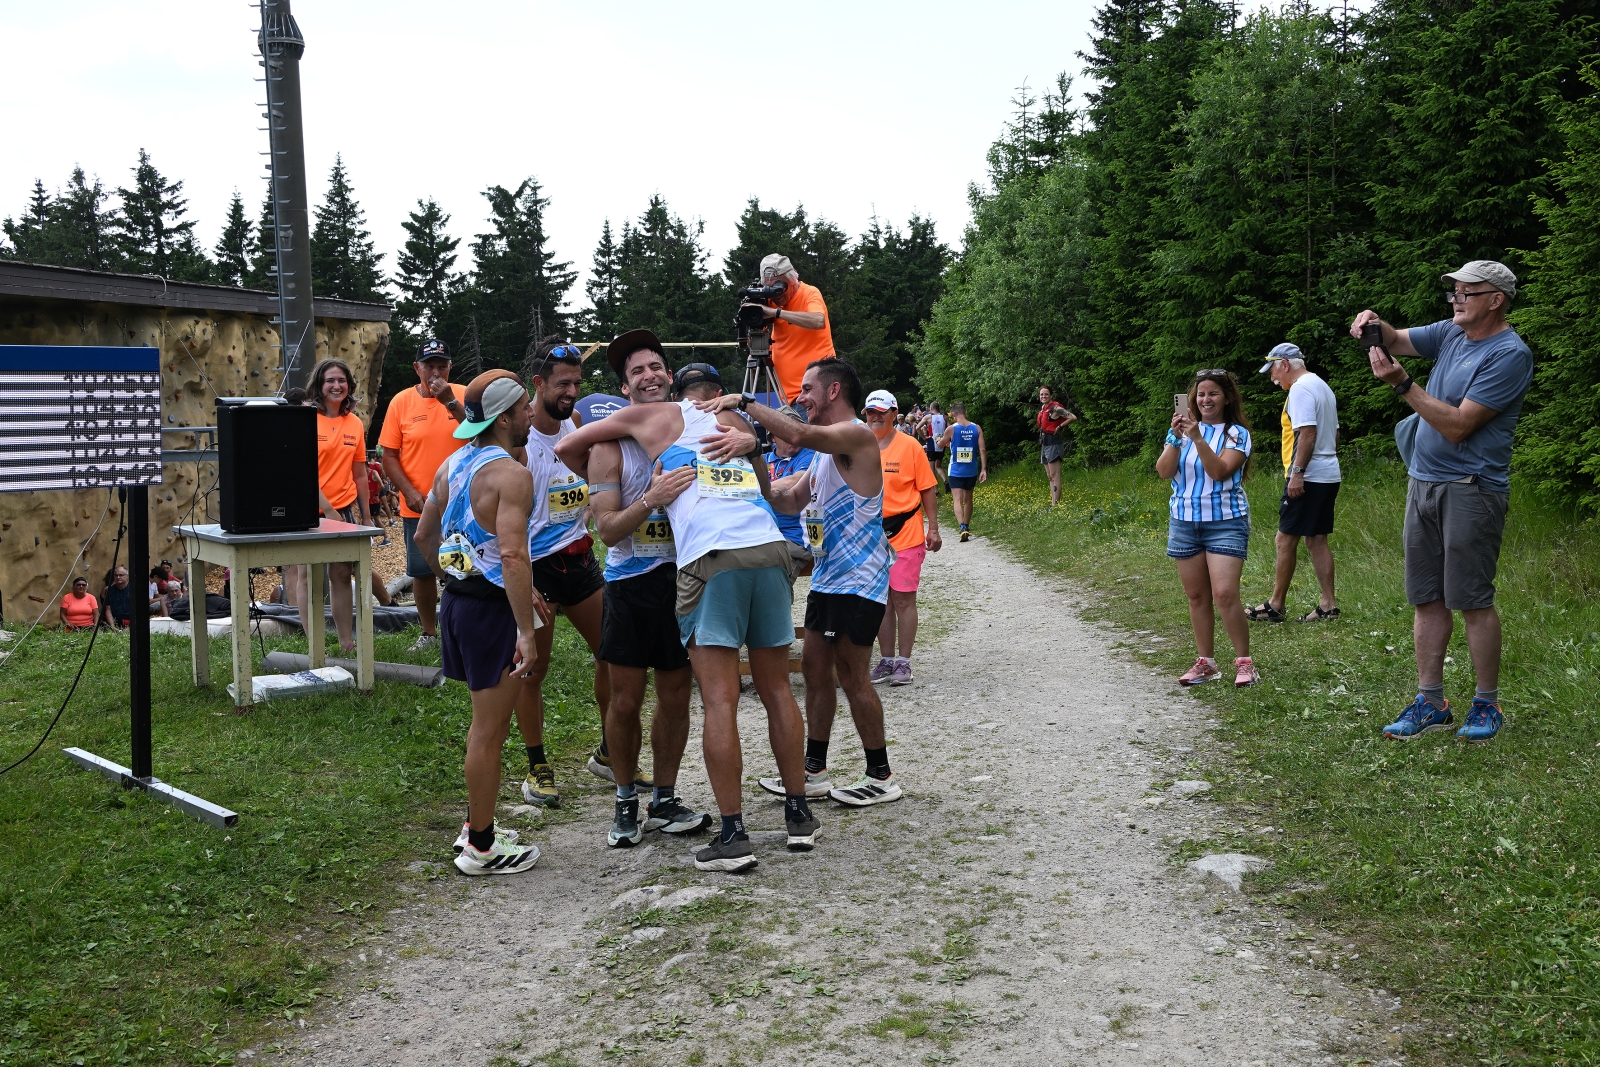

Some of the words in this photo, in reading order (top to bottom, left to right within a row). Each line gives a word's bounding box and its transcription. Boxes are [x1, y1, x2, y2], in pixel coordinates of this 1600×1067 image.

[711, 468, 744, 483] 395
[560, 488, 584, 506] 396
[646, 522, 674, 539] 437
